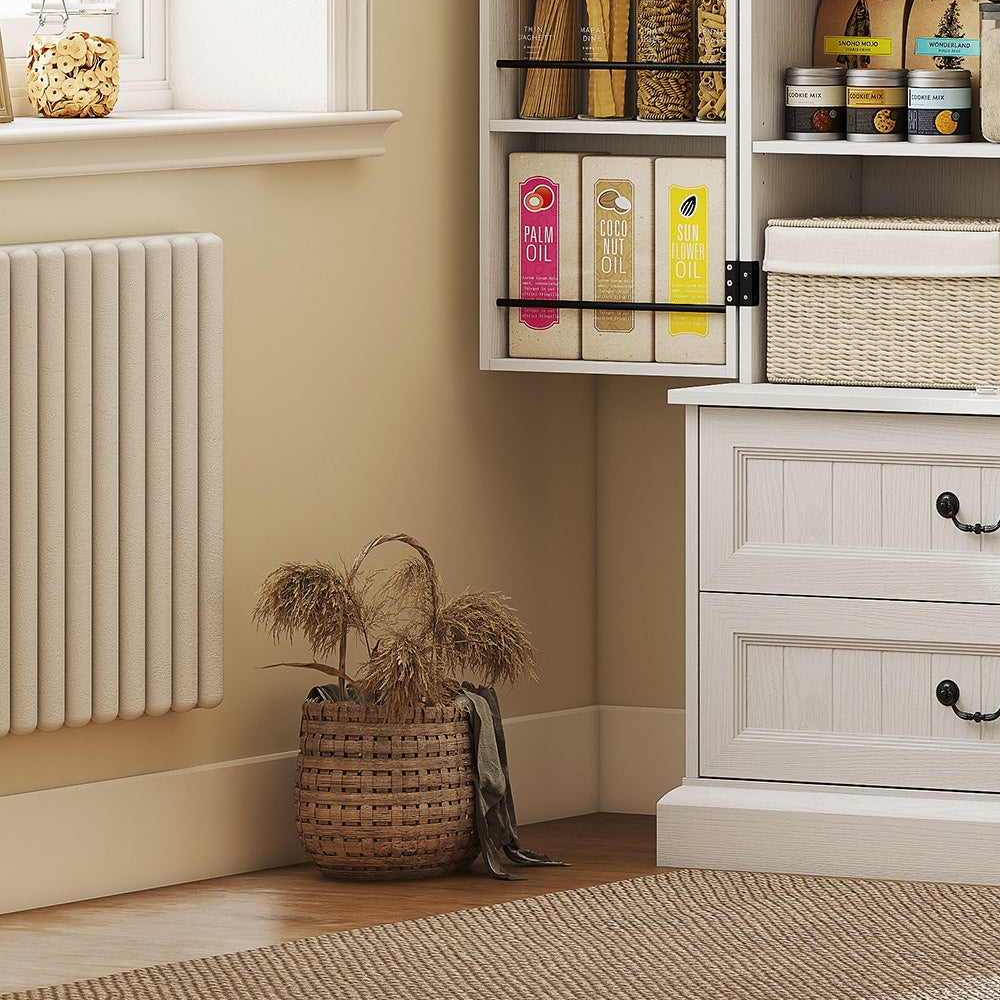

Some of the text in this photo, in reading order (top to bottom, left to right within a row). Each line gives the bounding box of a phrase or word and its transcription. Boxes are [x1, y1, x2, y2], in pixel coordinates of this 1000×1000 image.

[524, 225, 554, 243] PALM
[600, 220, 627, 236] COCO
[677, 224, 698, 242] SUN
[526, 244, 552, 262] OIL
[604, 238, 624, 255] NUT
[672, 242, 704, 260] FLOWER
[601, 256, 626, 274] OIL
[676, 261, 702, 279] OIL
